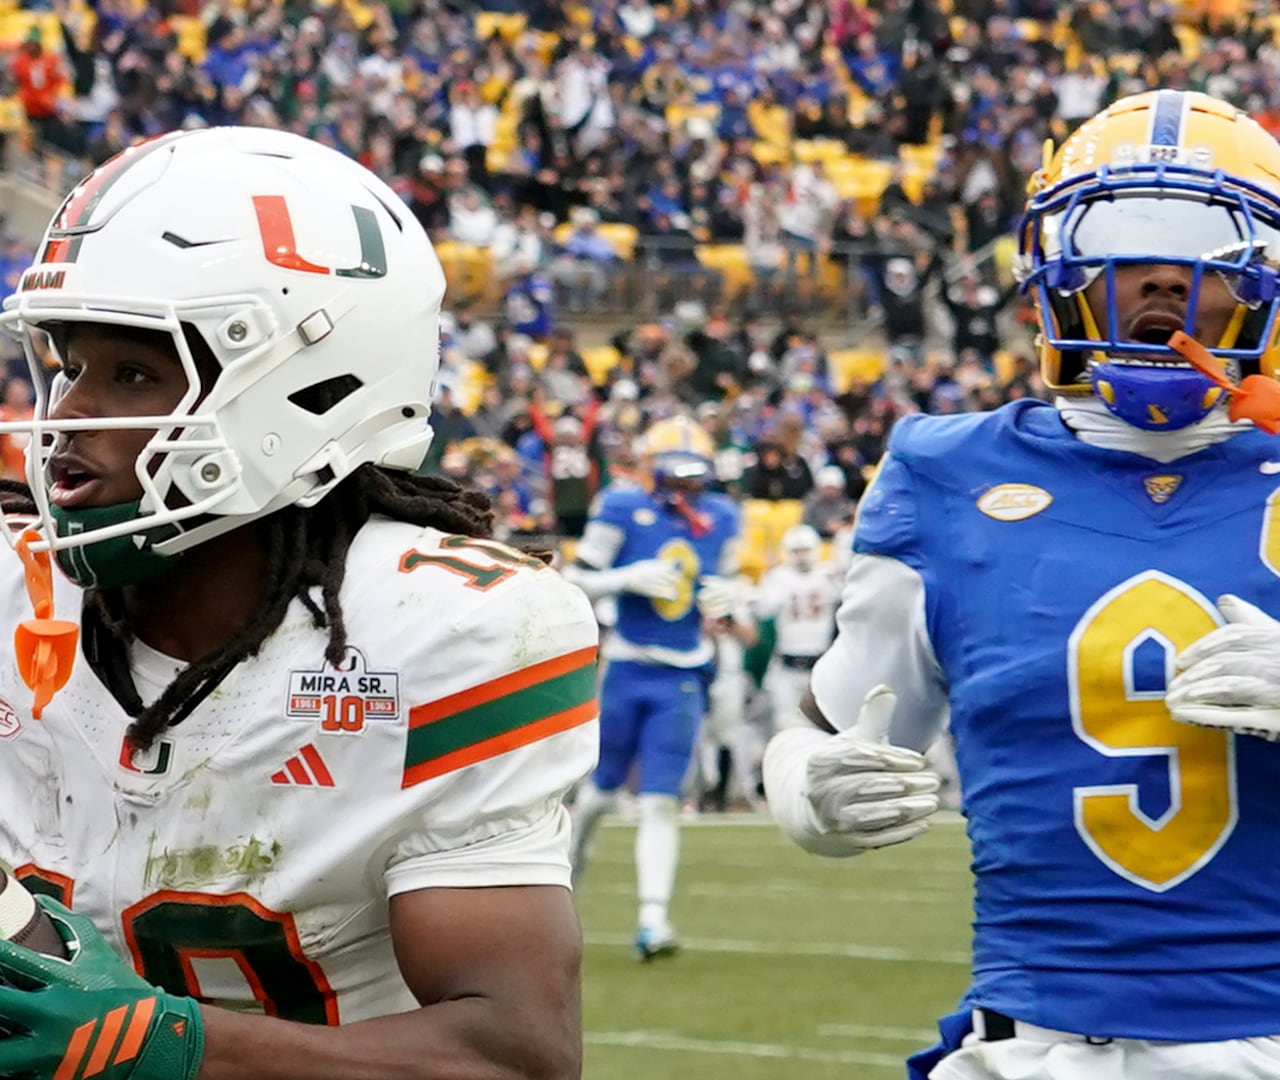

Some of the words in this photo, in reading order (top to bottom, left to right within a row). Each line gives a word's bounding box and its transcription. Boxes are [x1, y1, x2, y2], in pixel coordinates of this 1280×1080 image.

[22, 270, 66, 292] MIAMI
[300, 676, 350, 693] MIRA
[358, 677, 387, 693] SR.
[321, 694, 365, 732] 10
[1067, 569, 1239, 893] 9
